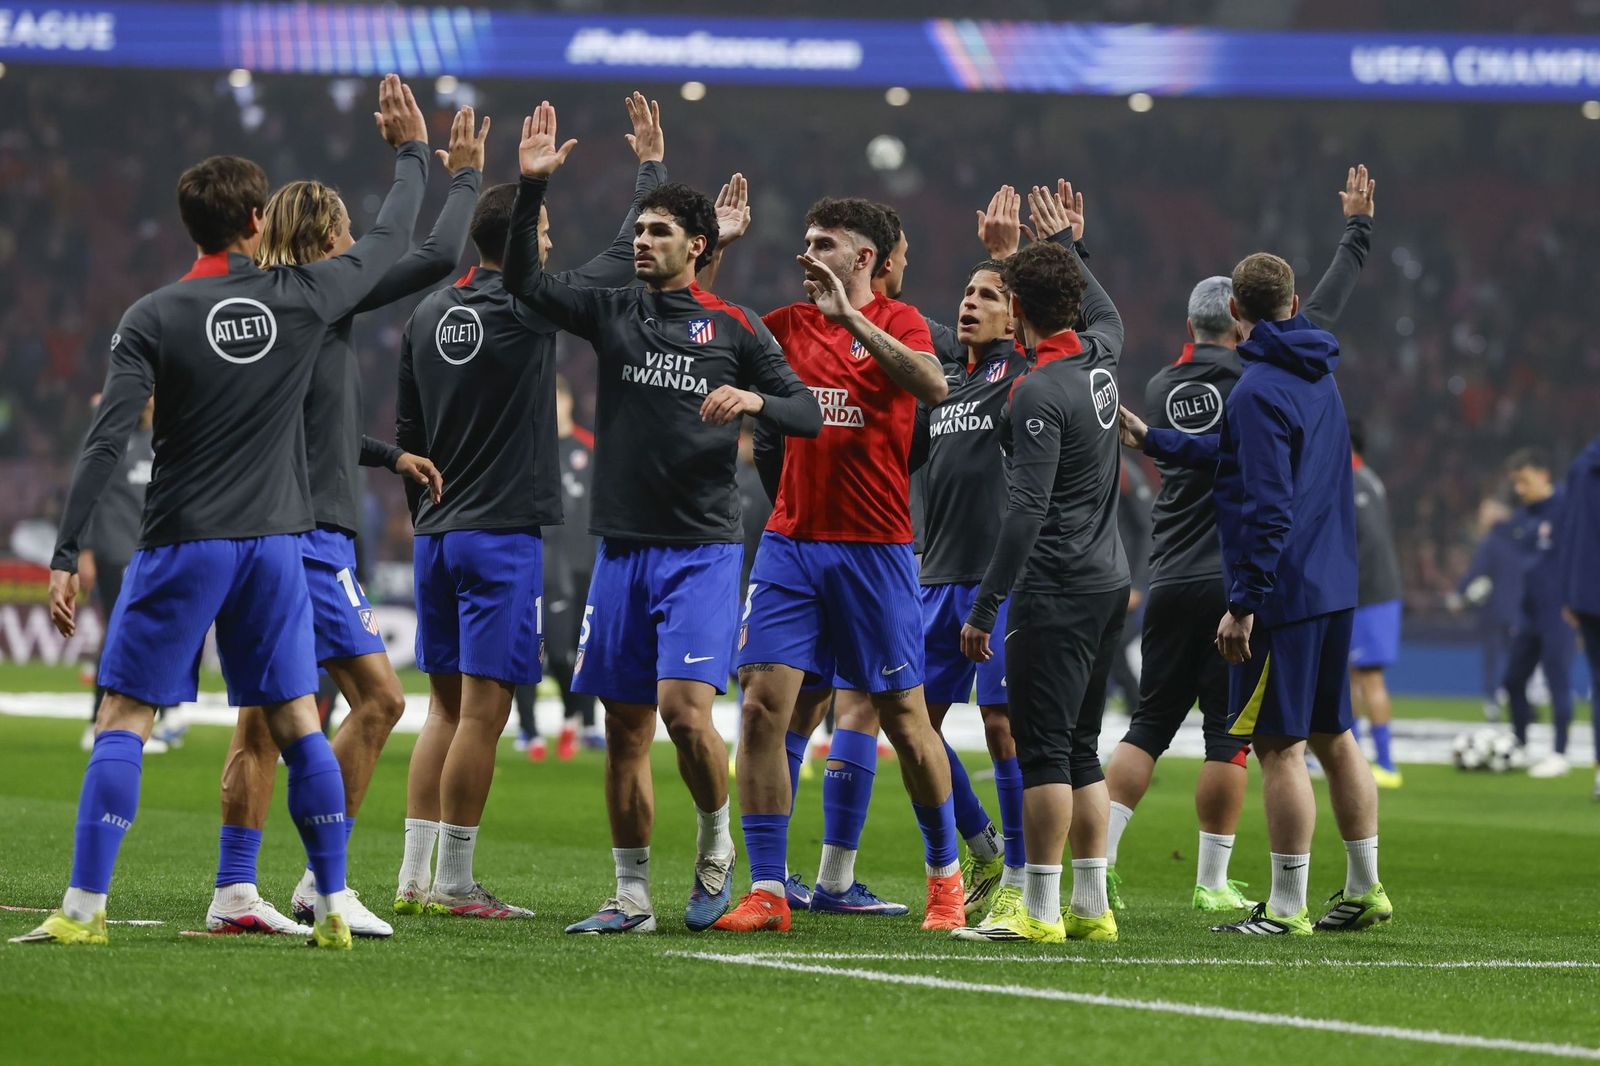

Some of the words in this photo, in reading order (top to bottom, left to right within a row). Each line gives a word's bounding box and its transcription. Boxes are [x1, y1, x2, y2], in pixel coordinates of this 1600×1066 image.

[1350, 45, 1450, 85] UEFA
[214, 315, 269, 344] ATLETI
[440, 322, 476, 345] ATLETI
[644, 351, 695, 374] VISIT
[621, 364, 709, 396] RWANDA
[810, 389, 846, 406] ISIT
[940, 400, 981, 420] VISIT
[1172, 393, 1214, 420] ATLETI
[823, 407, 862, 424] NDA
[336, 567, 365, 607] 1
[579, 604, 595, 645] 5
[101, 812, 133, 832] ATLET
